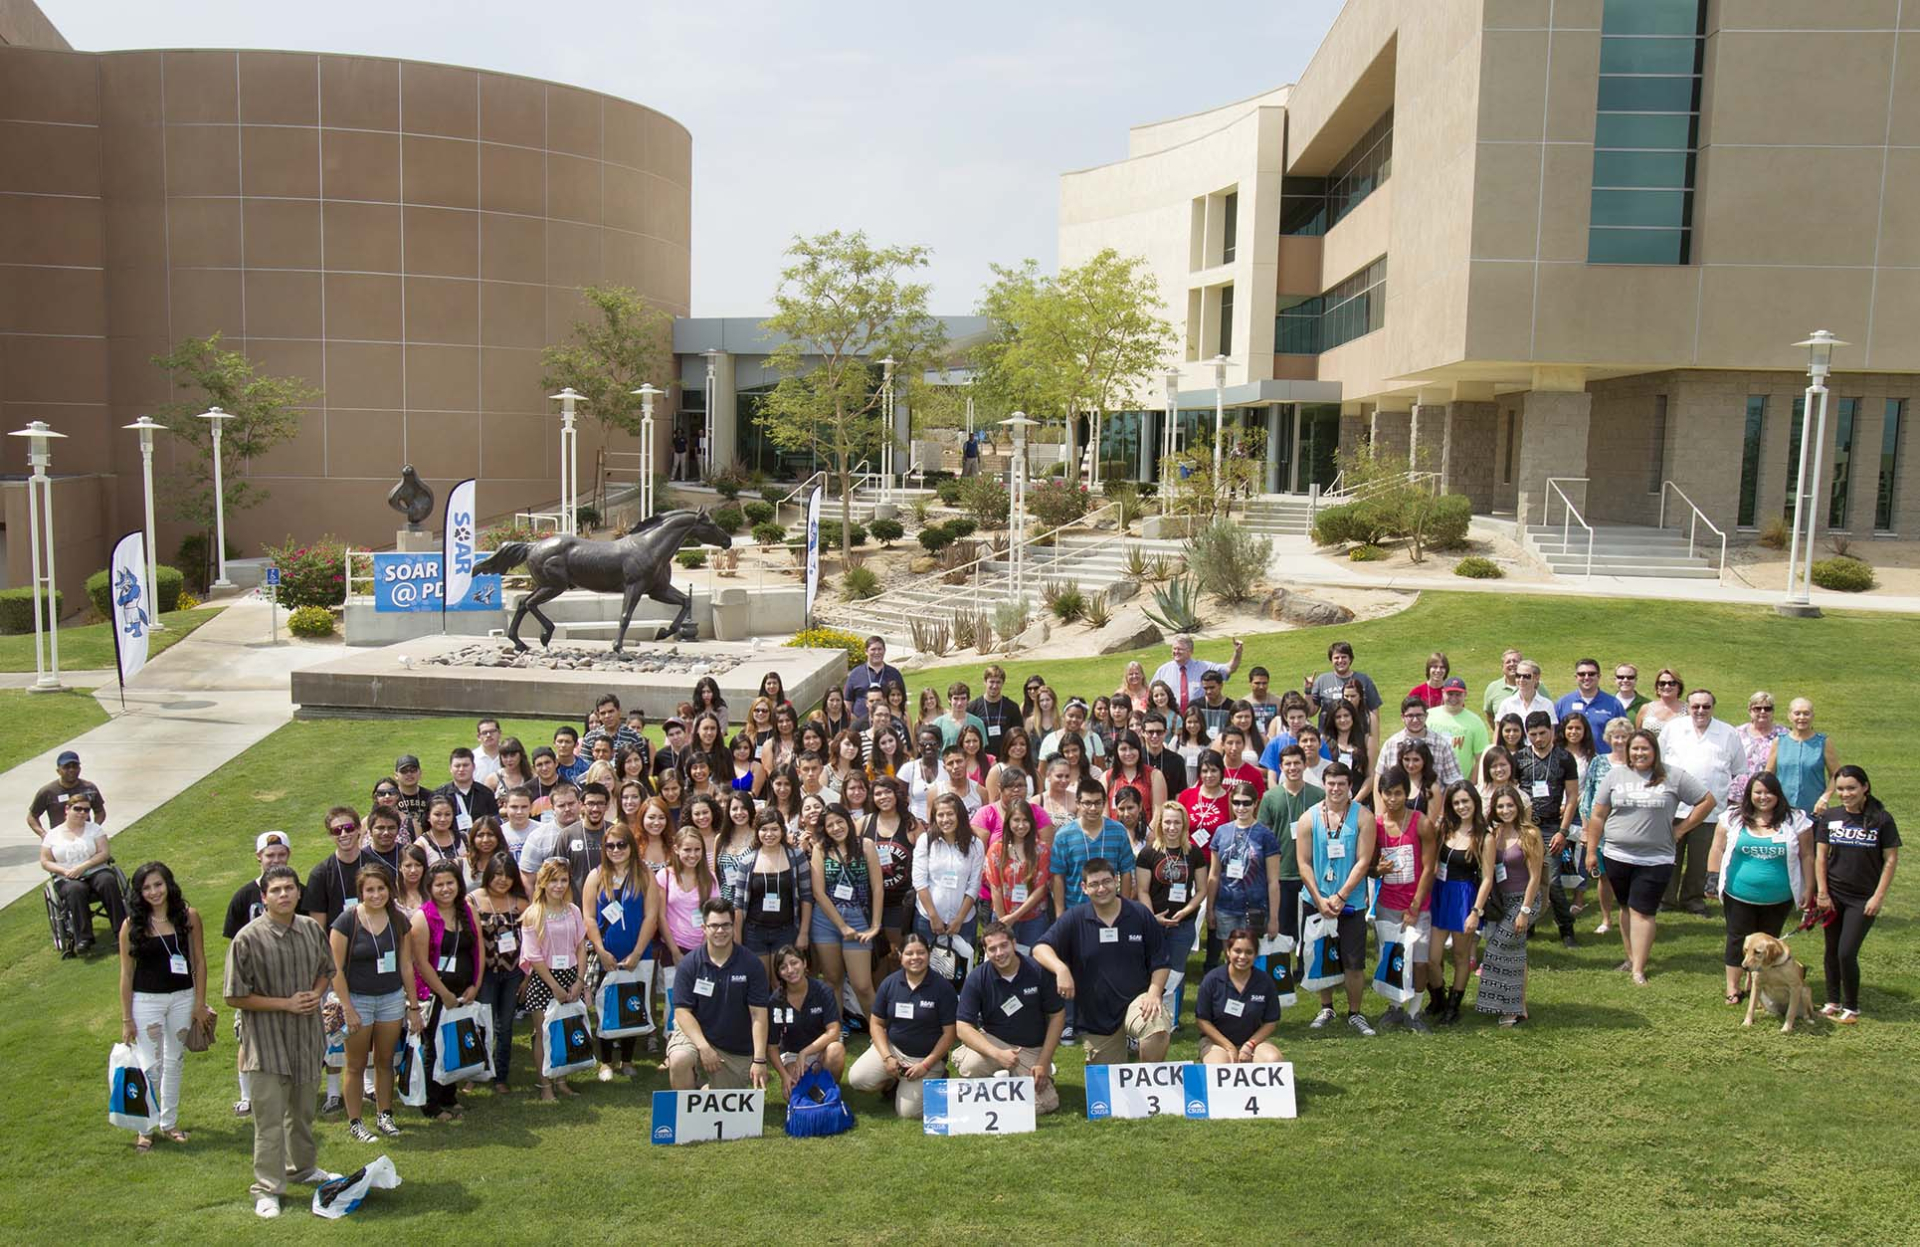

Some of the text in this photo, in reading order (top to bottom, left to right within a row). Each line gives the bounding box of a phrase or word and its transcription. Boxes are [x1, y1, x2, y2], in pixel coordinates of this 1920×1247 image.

[385, 562, 438, 581] SOAR
[391, 582, 443, 607] @ PD
[1741, 845, 1786, 856] CSUSB
[1119, 1065, 1184, 1088] PACK
[1216, 1066, 1285, 1088] PACK
[957, 1080, 1026, 1103] PACK
[686, 1093, 755, 1113] PACK
[1146, 1095, 1161, 1116] 3
[1244, 1096, 1260, 1115] 4
[713, 1120, 723, 1139] 1
[984, 1111, 999, 1131] 2
